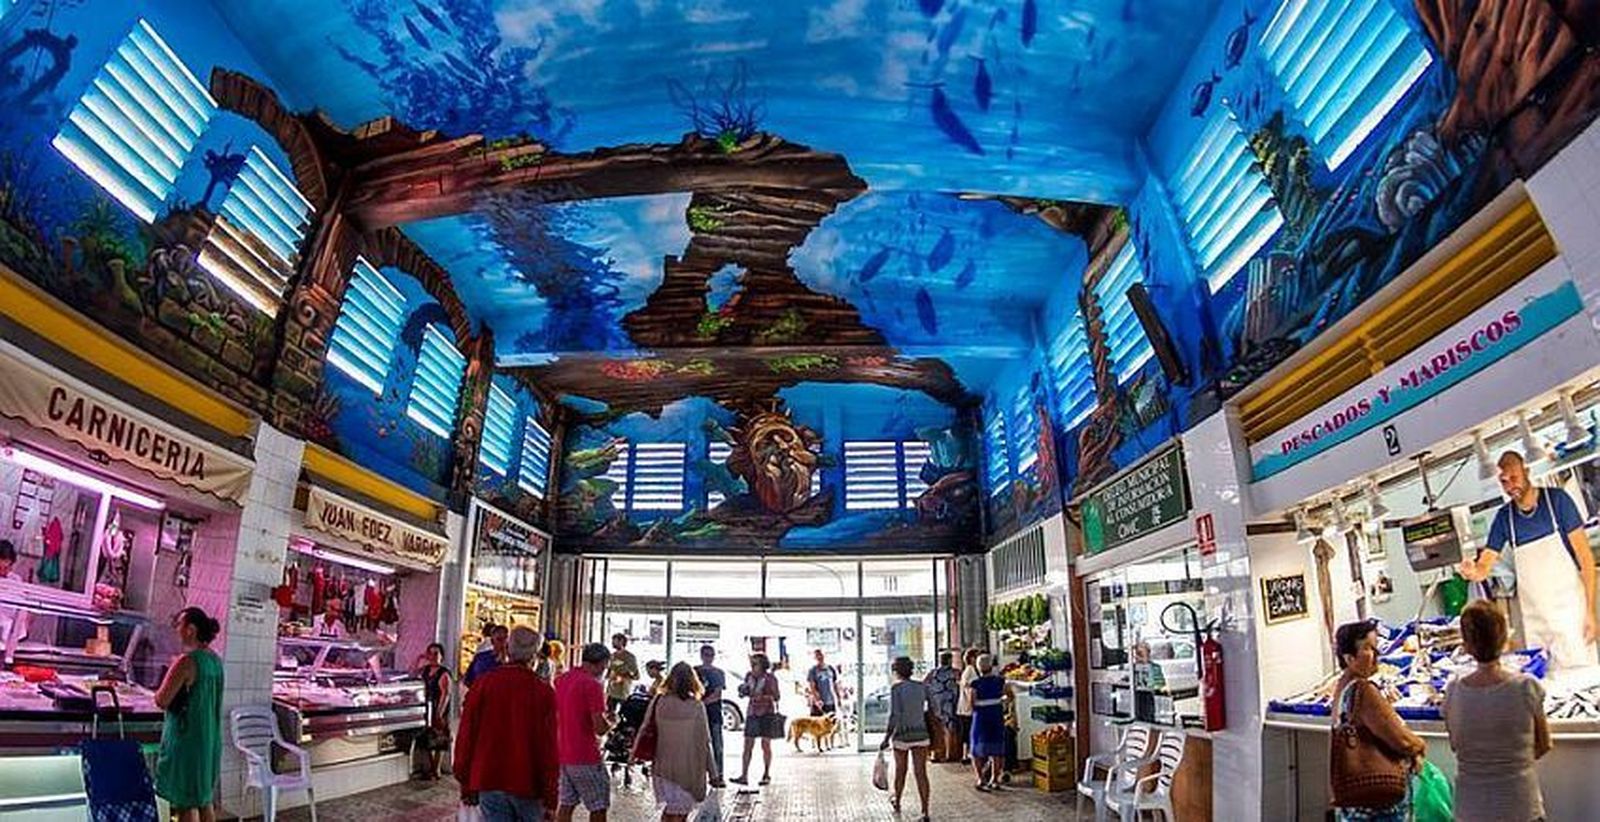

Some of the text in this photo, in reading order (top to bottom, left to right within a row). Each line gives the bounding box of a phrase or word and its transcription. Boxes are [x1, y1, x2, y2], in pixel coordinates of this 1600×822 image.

[1280, 309, 1523, 455] PESCADOS Y MARISCOS
[47, 386, 206, 480] CARNICERIA
[1384, 427, 1399, 453] 2
[320, 501, 355, 533] JUAN
[402, 531, 442, 559] VARGAS
